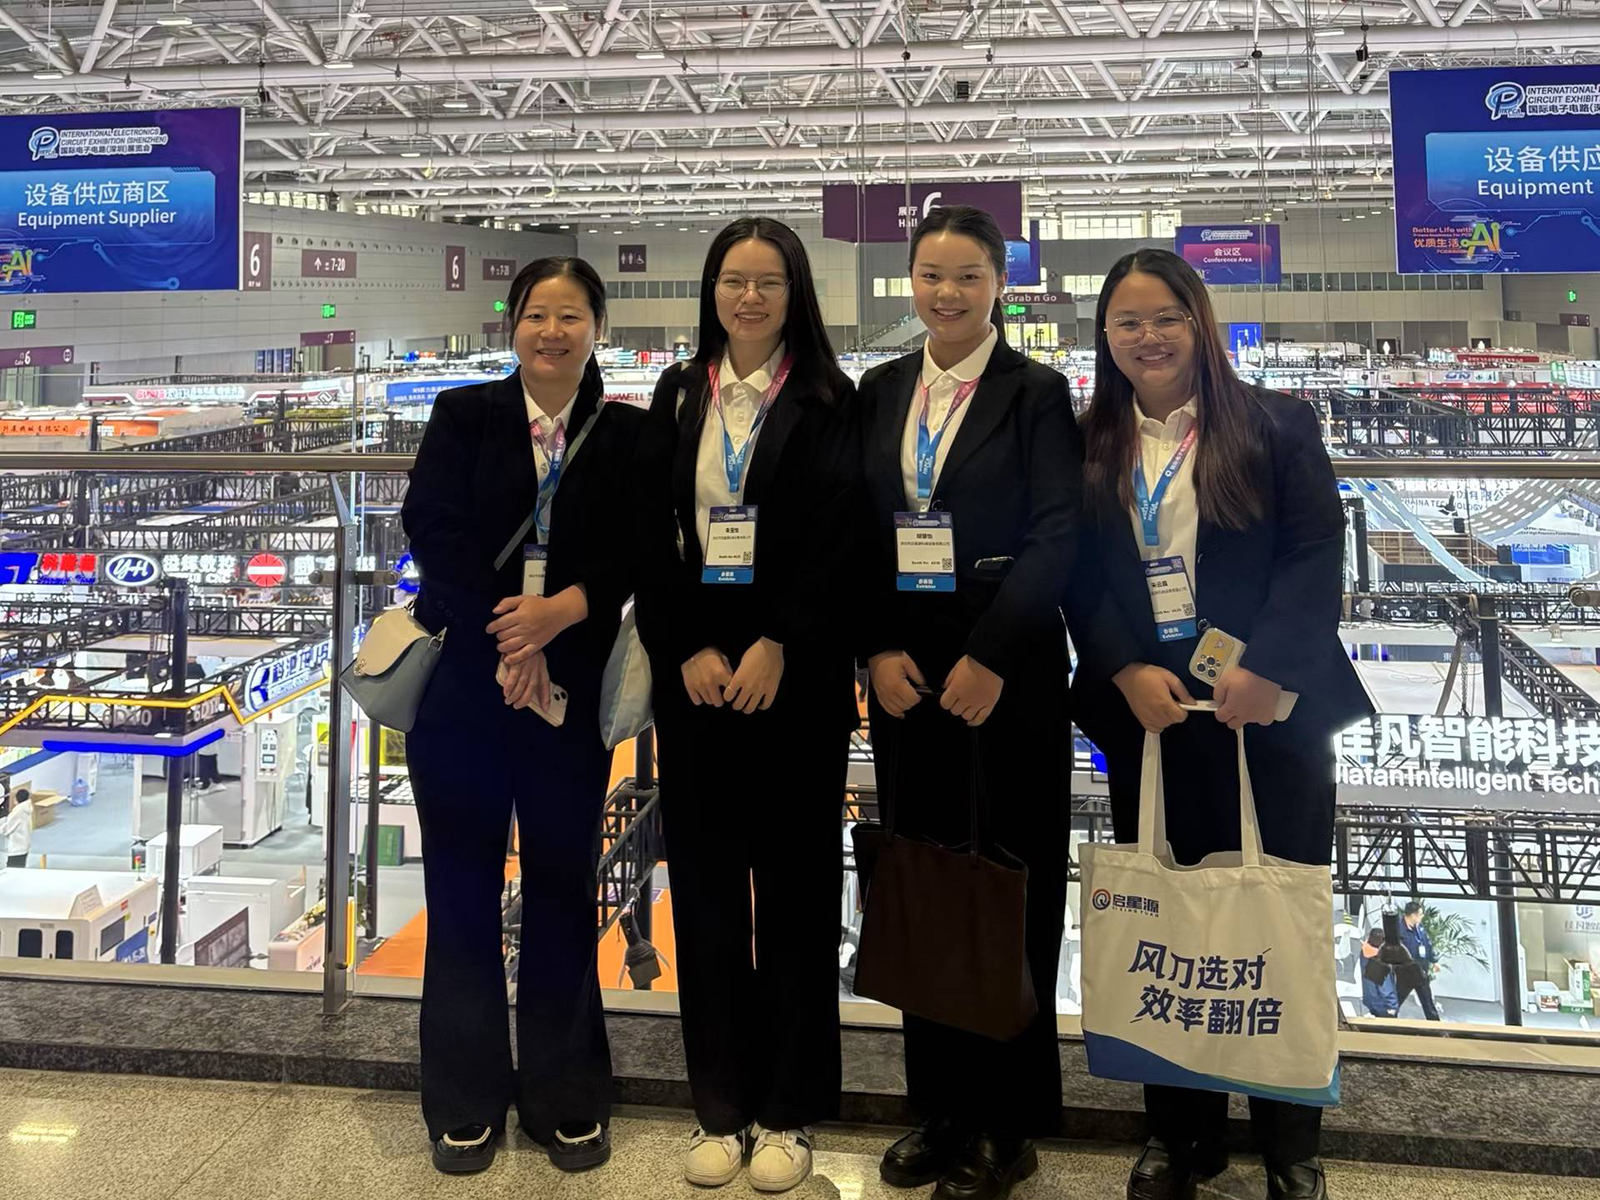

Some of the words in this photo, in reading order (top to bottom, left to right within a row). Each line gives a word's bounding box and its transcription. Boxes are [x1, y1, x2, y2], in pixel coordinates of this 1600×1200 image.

[1527, 86, 1596, 95] INTERNATIONAL
[1527, 95, 1564, 104] CIRCUIT
[61, 129, 111, 138] INTERNATIONAL
[113, 127, 160, 136] ELECTRONICS
[61, 138, 87, 146] CIRCUIT
[88, 137, 126, 145] EXHIBITION
[127, 135, 168, 145] (SHENZHEN)
[25, 180, 170, 207] 设备供应商区
[1478, 179, 1594, 199] Equipment
[18, 211, 105, 229] Equipment
[109, 208, 177, 227] Supplier
[250, 243, 260, 277] 6
[1213, 247, 1241, 256] 会议区
[331, 258, 346, 272] 7-20
[452, 255, 459, 280] 6
[1006, 294, 1031, 302] Grab
[1042, 294, 1057, 302] Go
[25, 350, 31, 365] 6
[1333, 714, 1600, 766] 佳凡智能科技
[1541, 771, 1600, 796] Tech
[1113, 894, 1160, 913] 启星源
[1127, 939, 1267, 991] 风刀选对
[1134, 984, 1284, 1037] 效率翻倍
